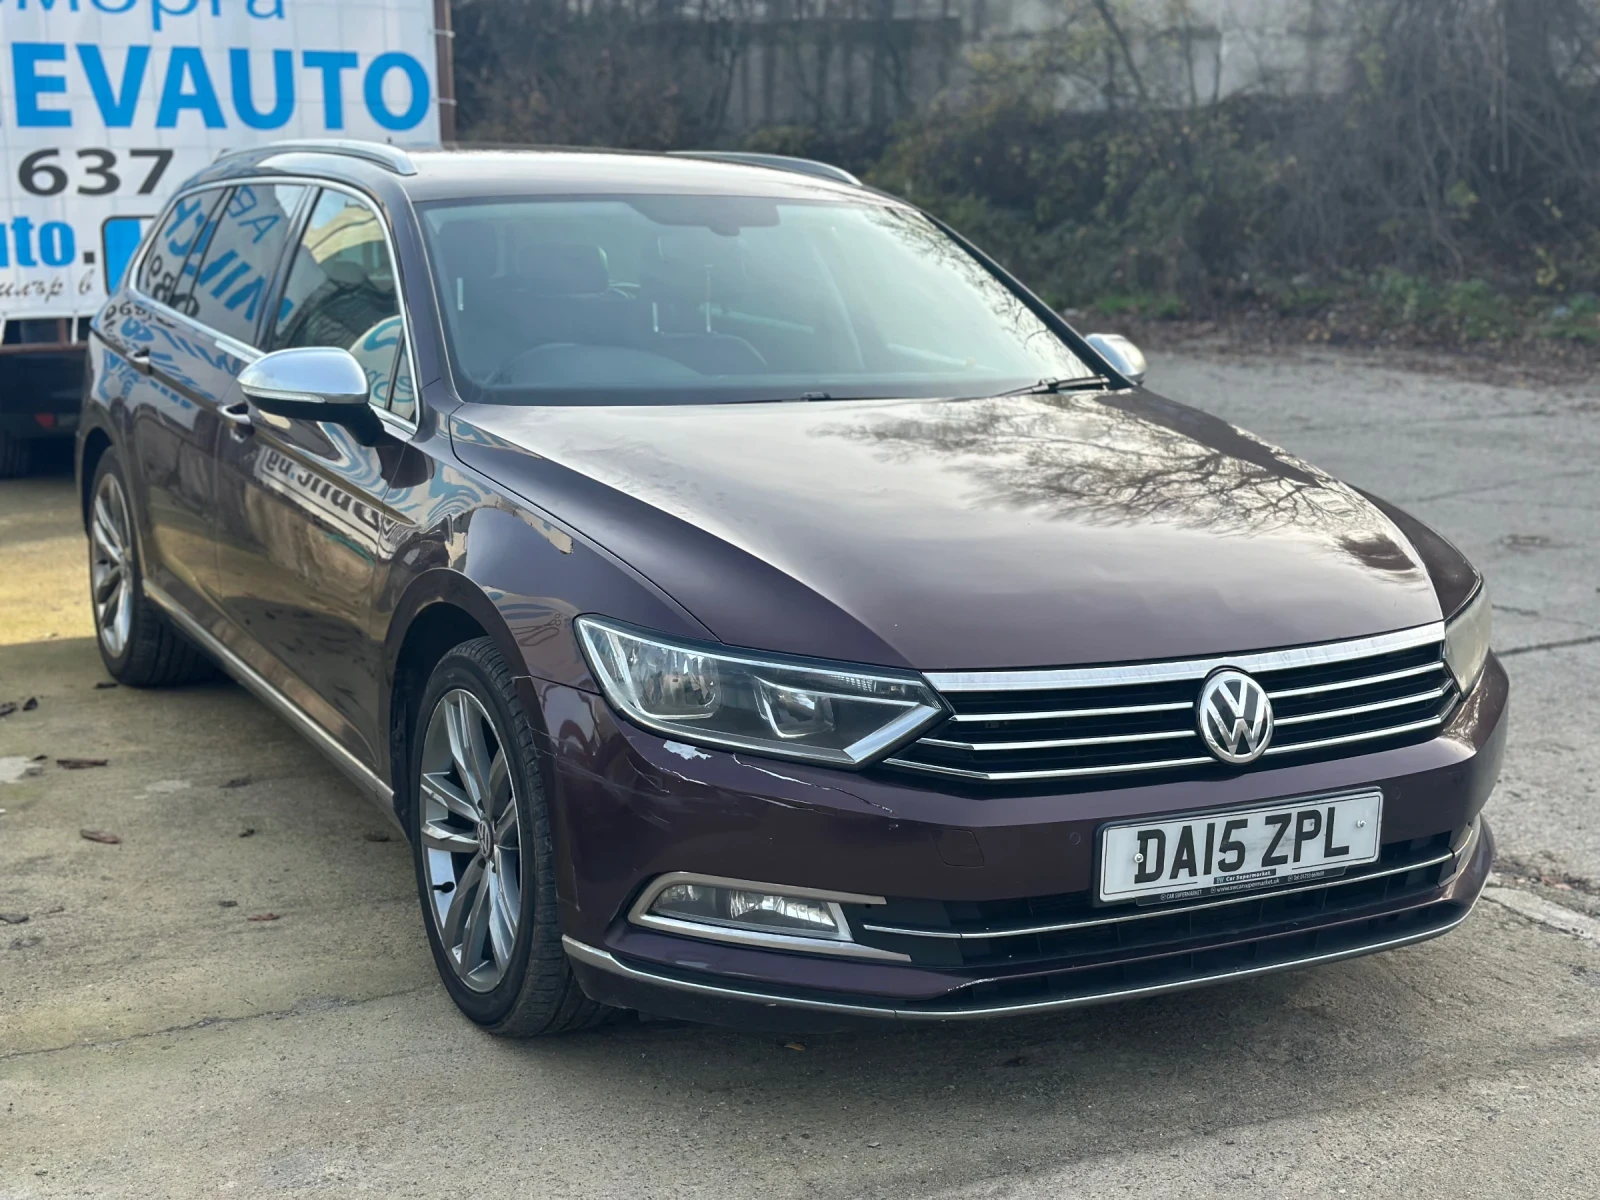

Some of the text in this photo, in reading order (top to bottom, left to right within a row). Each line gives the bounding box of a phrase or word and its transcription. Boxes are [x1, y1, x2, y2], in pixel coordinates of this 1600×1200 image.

[11, 42, 430, 131] EVAUTO
[17, 147, 174, 196] 637
[1134, 807, 1350, 884] DA15 ZPL
